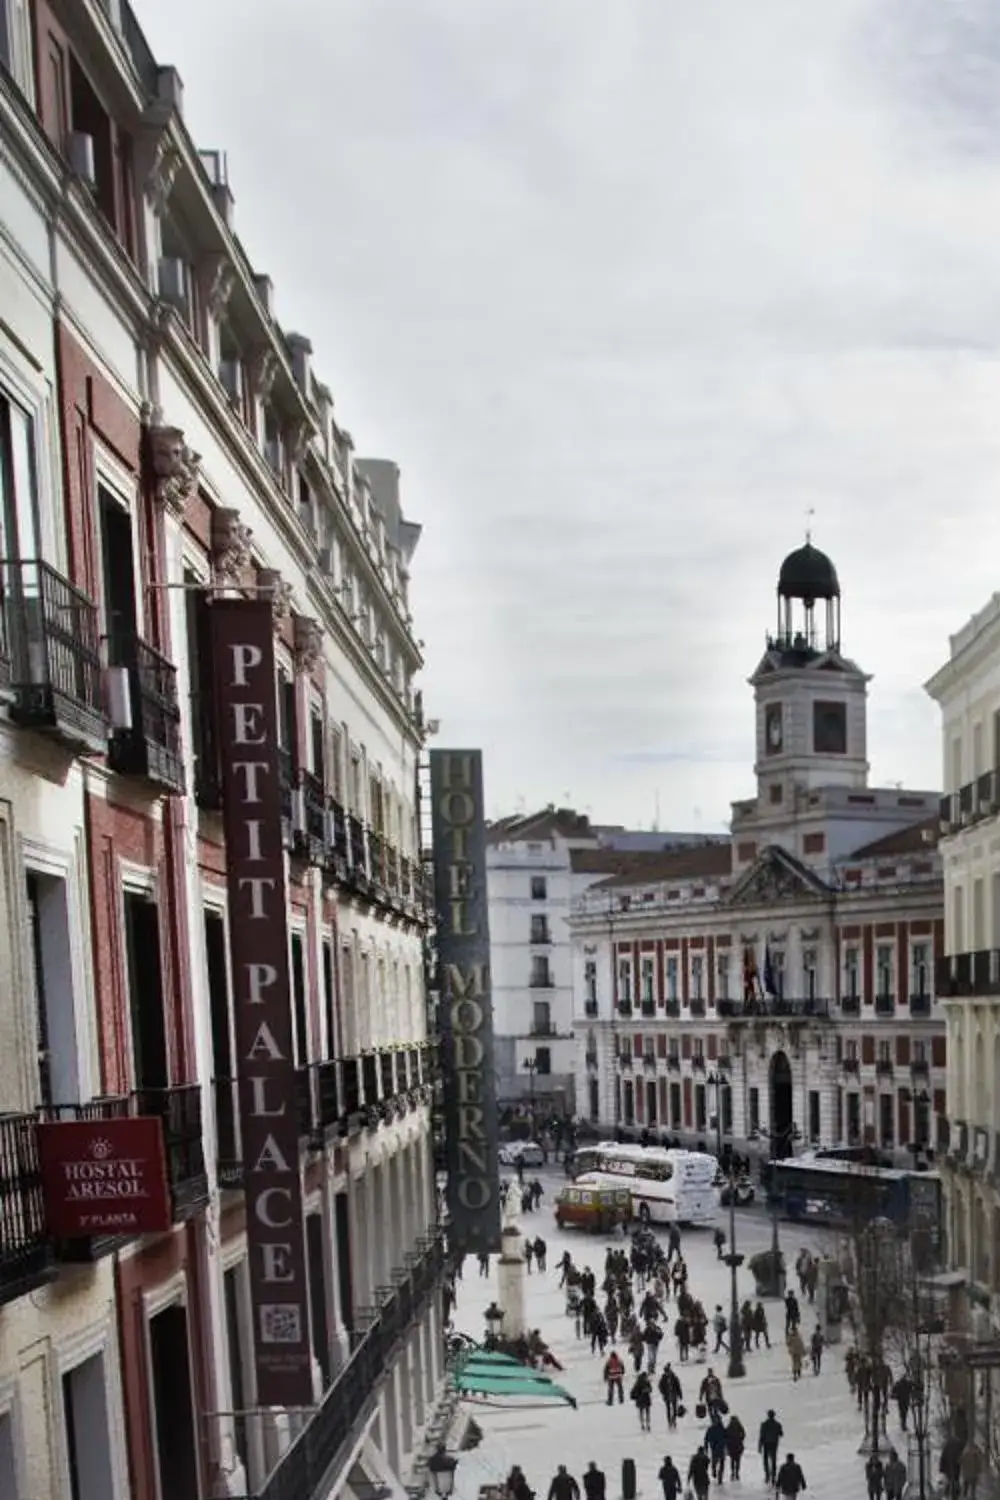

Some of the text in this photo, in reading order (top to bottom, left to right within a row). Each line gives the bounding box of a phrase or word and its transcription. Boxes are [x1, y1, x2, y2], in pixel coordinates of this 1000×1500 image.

[228, 643, 296, 1284] PETIT PALACE
[439, 754, 491, 1210] HOTEL MODERNO
[64, 1160, 144, 1180] HOSTAL
[68, 1180, 145, 1198] ARESOL
[91, 1212, 138, 1225] PLANTA
